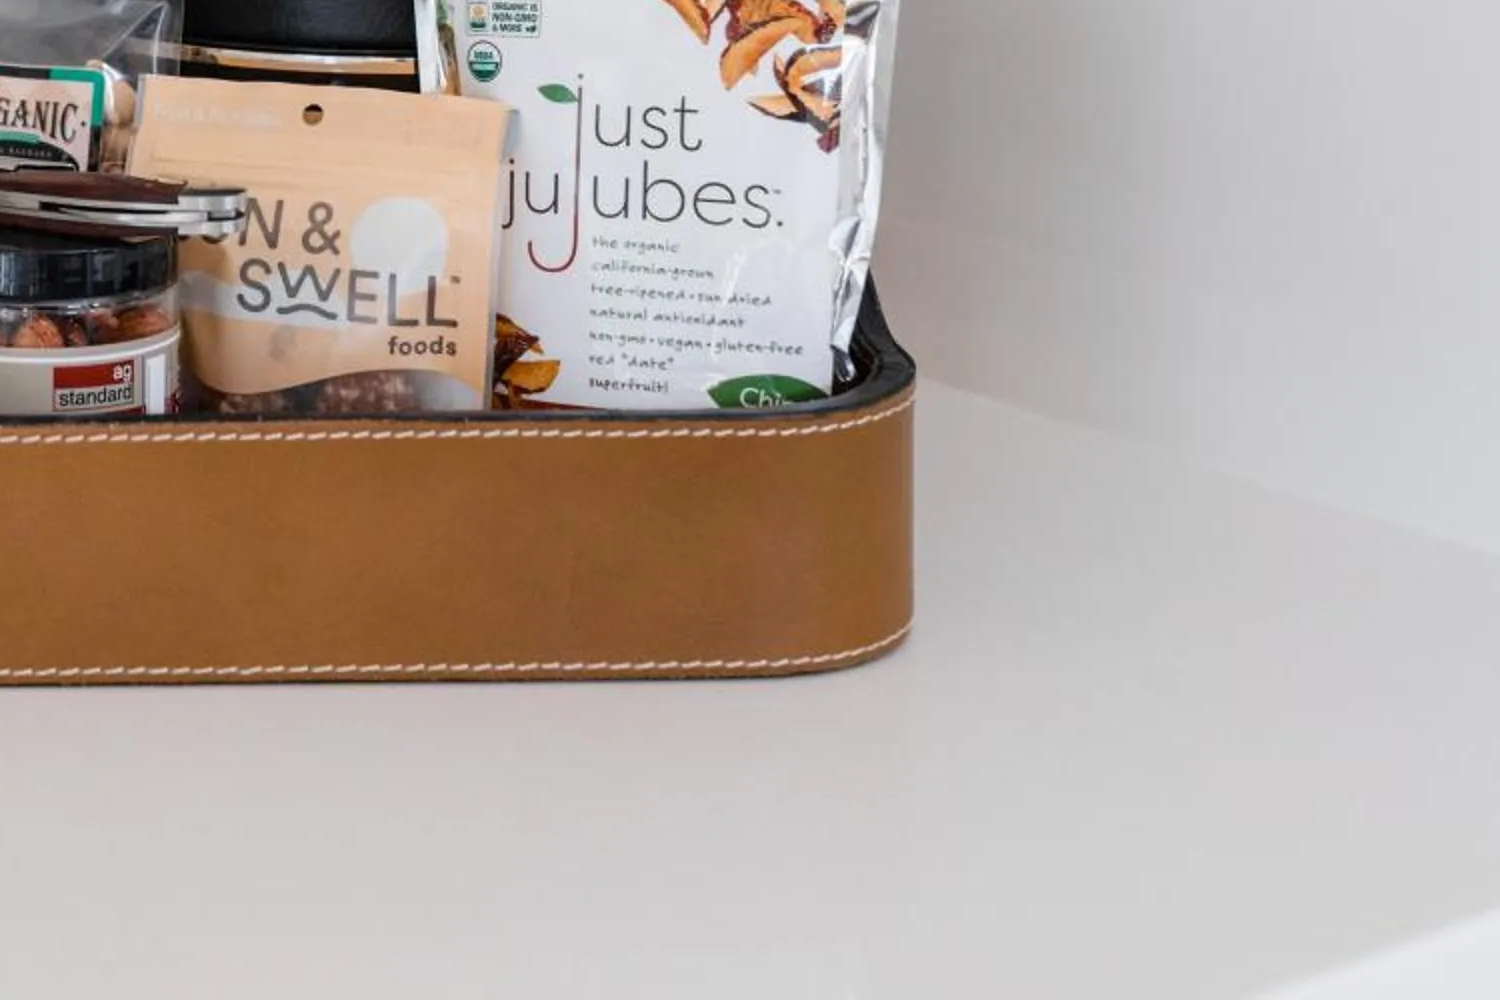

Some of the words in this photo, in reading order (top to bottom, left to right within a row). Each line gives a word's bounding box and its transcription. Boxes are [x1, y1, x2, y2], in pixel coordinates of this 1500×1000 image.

[301, 201, 341, 256] &
[592, 236, 619, 250] the
[623, 239, 680, 255] organic
[236, 257, 459, 328] SWELL
[589, 307, 649, 321] natural
[388, 335, 458, 357] foods
[588, 353, 616, 365] red
[112, 364, 132, 384] ag
[59, 384, 133, 407] standard
[739, 387, 793, 409] Chi
